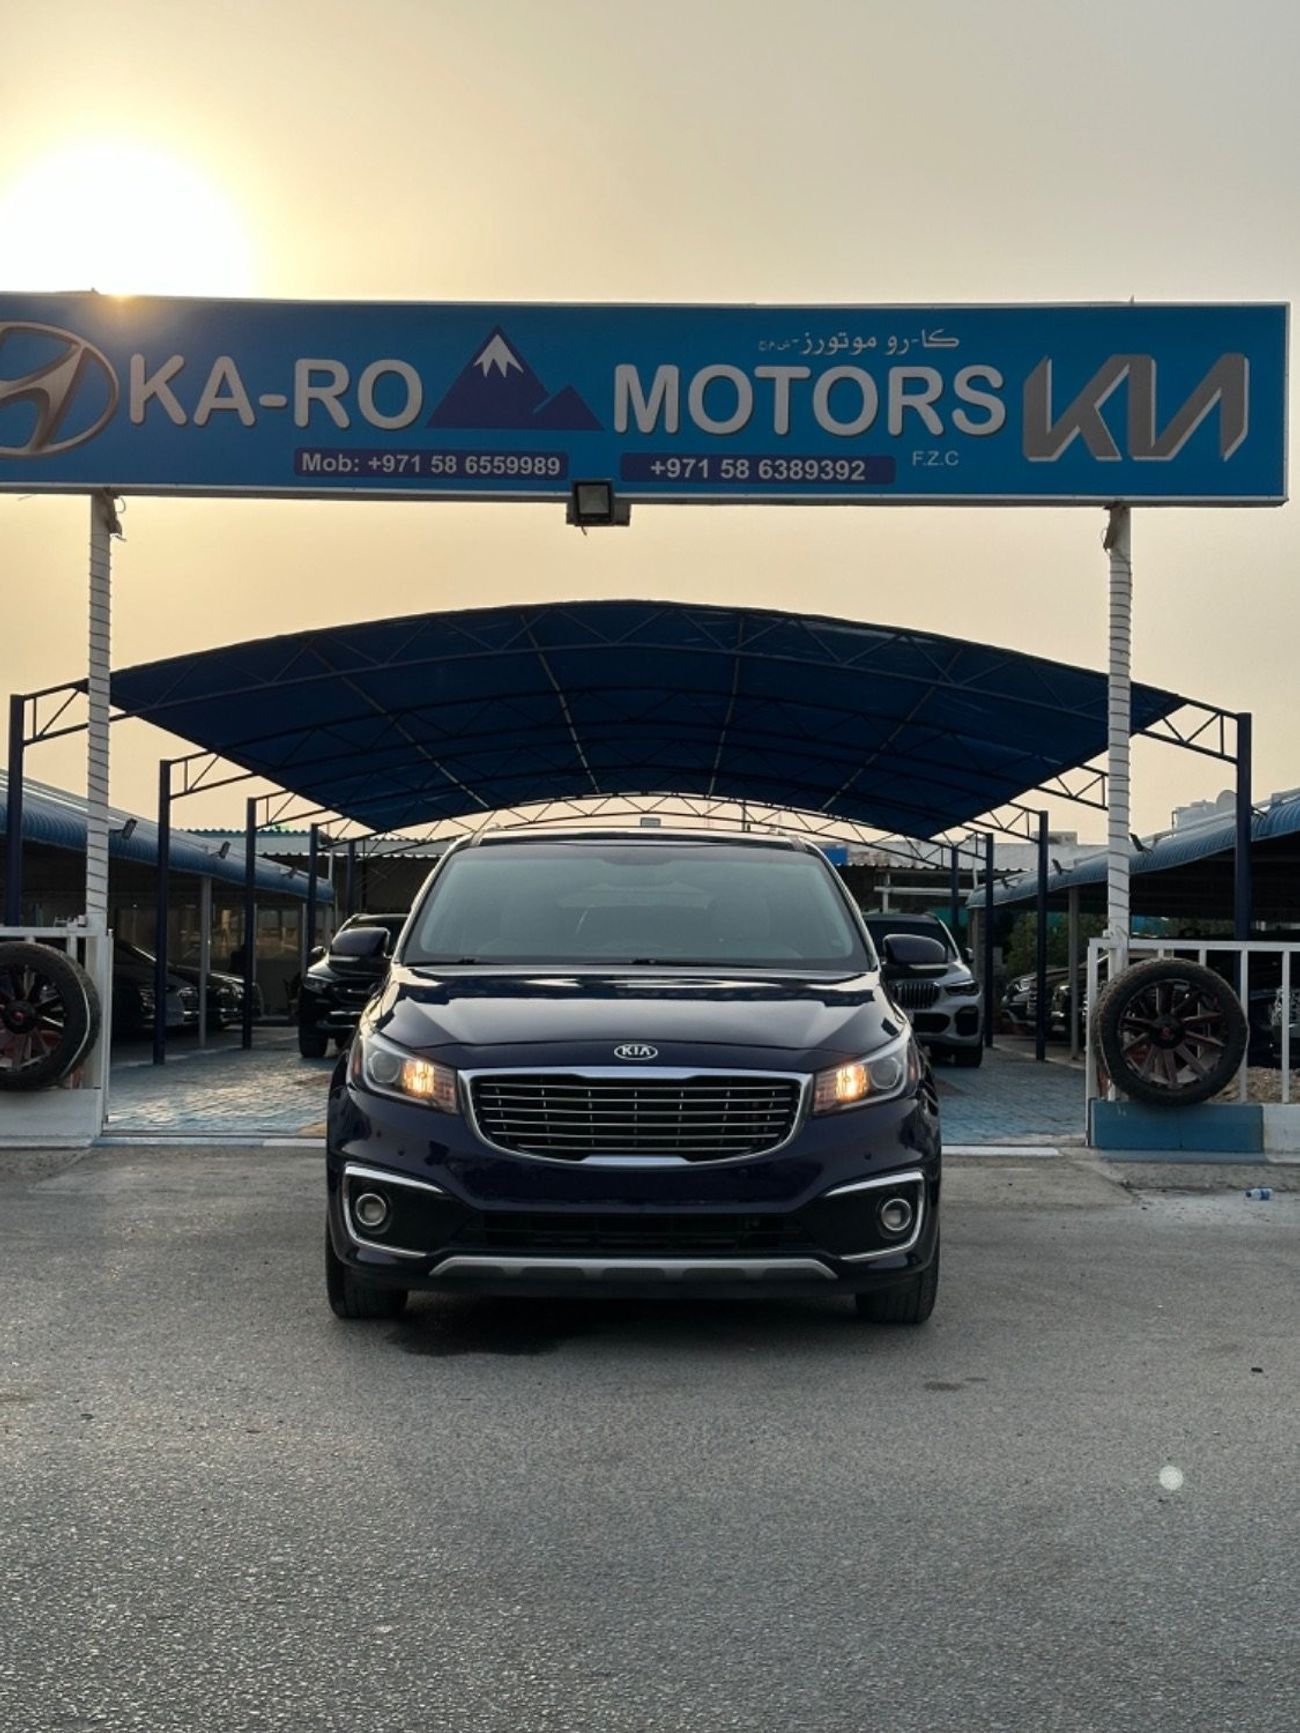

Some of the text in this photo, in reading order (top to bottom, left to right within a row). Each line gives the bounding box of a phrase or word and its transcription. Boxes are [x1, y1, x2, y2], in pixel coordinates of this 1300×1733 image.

[129, 353, 1007, 437] KA-RO MOTORS
[301, 453, 561, 476] Mob: +971 58 6559989
[650, 458, 866, 481] +971 58 6389392
[622, 1045, 651, 1056] KIA
